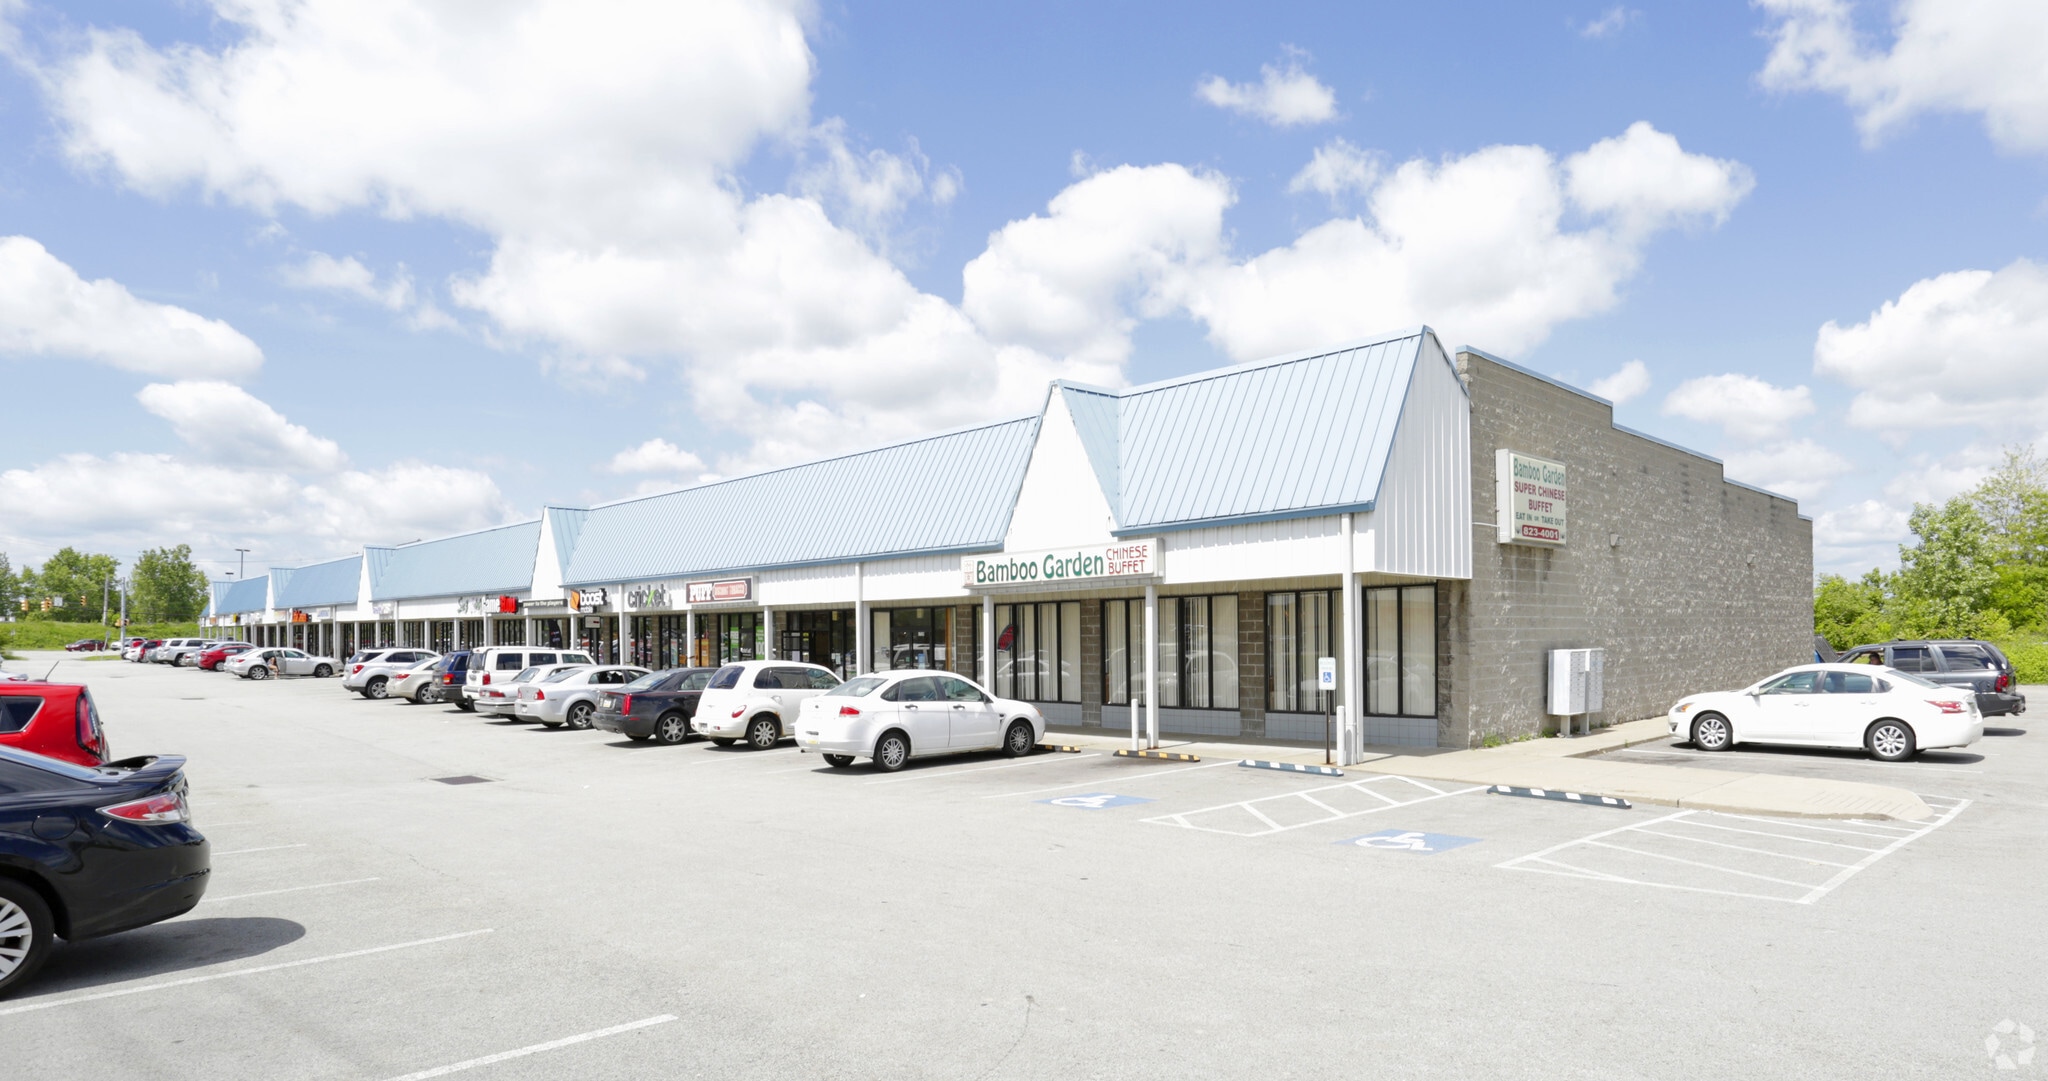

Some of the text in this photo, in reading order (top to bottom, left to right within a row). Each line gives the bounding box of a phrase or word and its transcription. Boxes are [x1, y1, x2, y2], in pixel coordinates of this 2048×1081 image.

[1513, 458, 1565, 486] Bamboo Garden
[1514, 481, 1565, 501] SUPER CHINESE
[1528, 499, 1553, 513] BUFFET
[1516, 512, 1525, 520] EAT
[1526, 513, 1533, 521] IN
[1541, 515, 1554, 525] TAKE
[1554, 517, 1564, 526] OUT
[1523, 527, 1559, 540] 823-4001
[1106, 545, 1148, 560] CHINESE
[976, 558, 1038, 583] Bamboo
[1043, 552, 1104, 578] Garden
[1108, 560, 1146, 575] BUFFET
[580, 589, 604, 606] boost
[627, 584, 666, 608] cricket
[689, 583, 713, 601] PUFF
